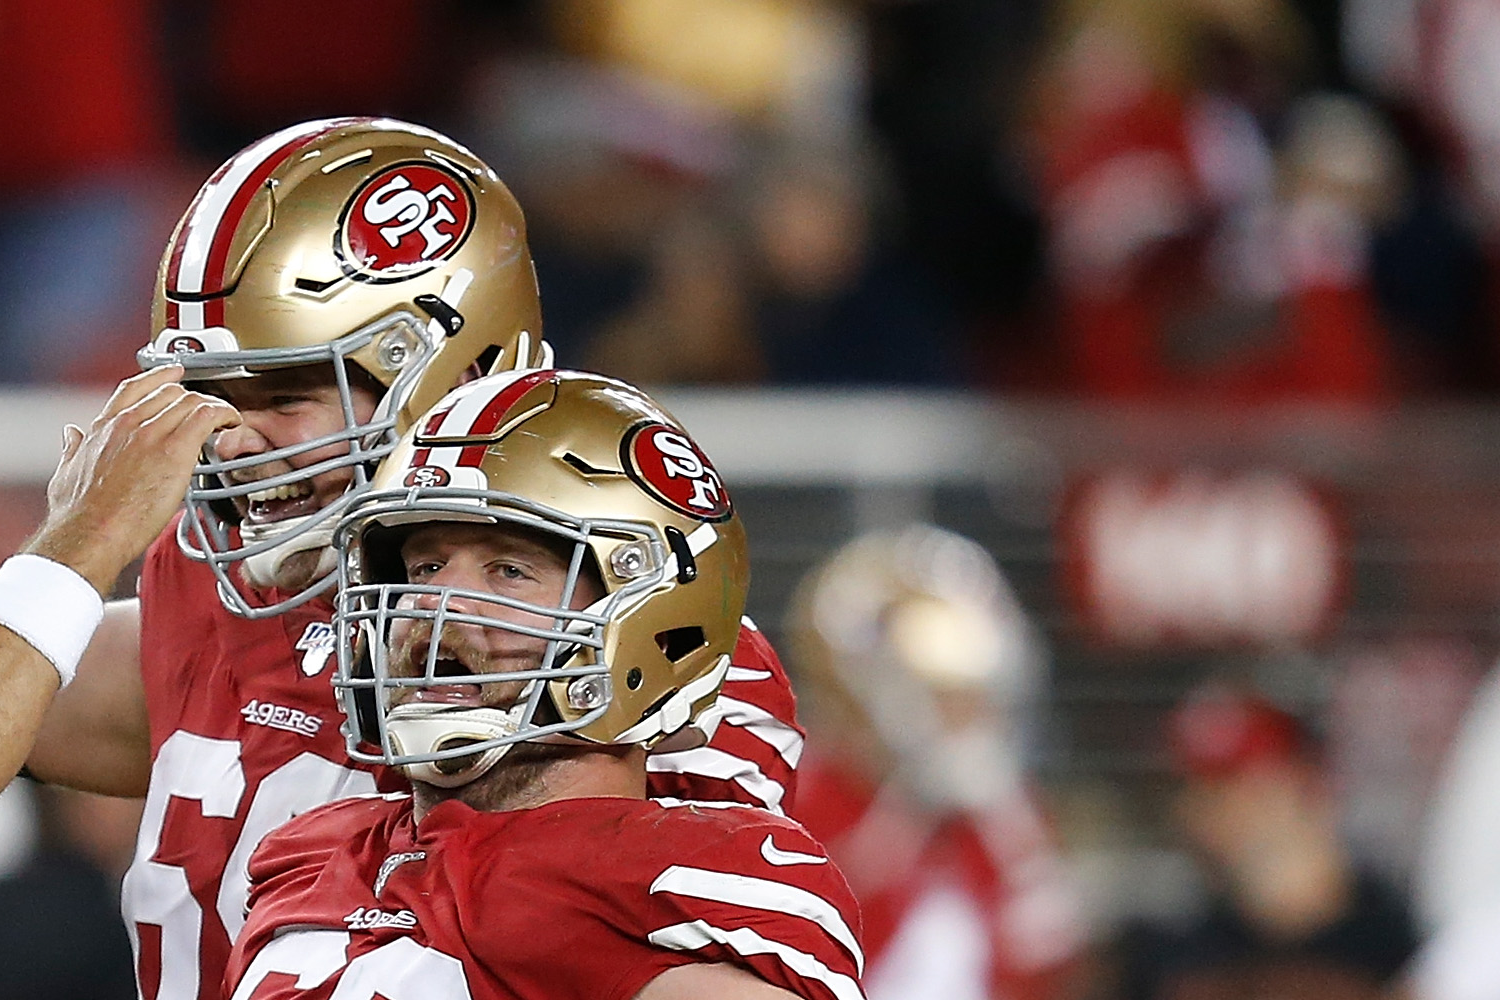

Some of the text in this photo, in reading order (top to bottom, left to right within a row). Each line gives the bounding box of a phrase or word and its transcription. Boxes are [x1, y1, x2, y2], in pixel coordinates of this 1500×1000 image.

[362, 173, 458, 261] SF
[652, 430, 723, 511] SF
[239, 698, 324, 738] 49ERS
